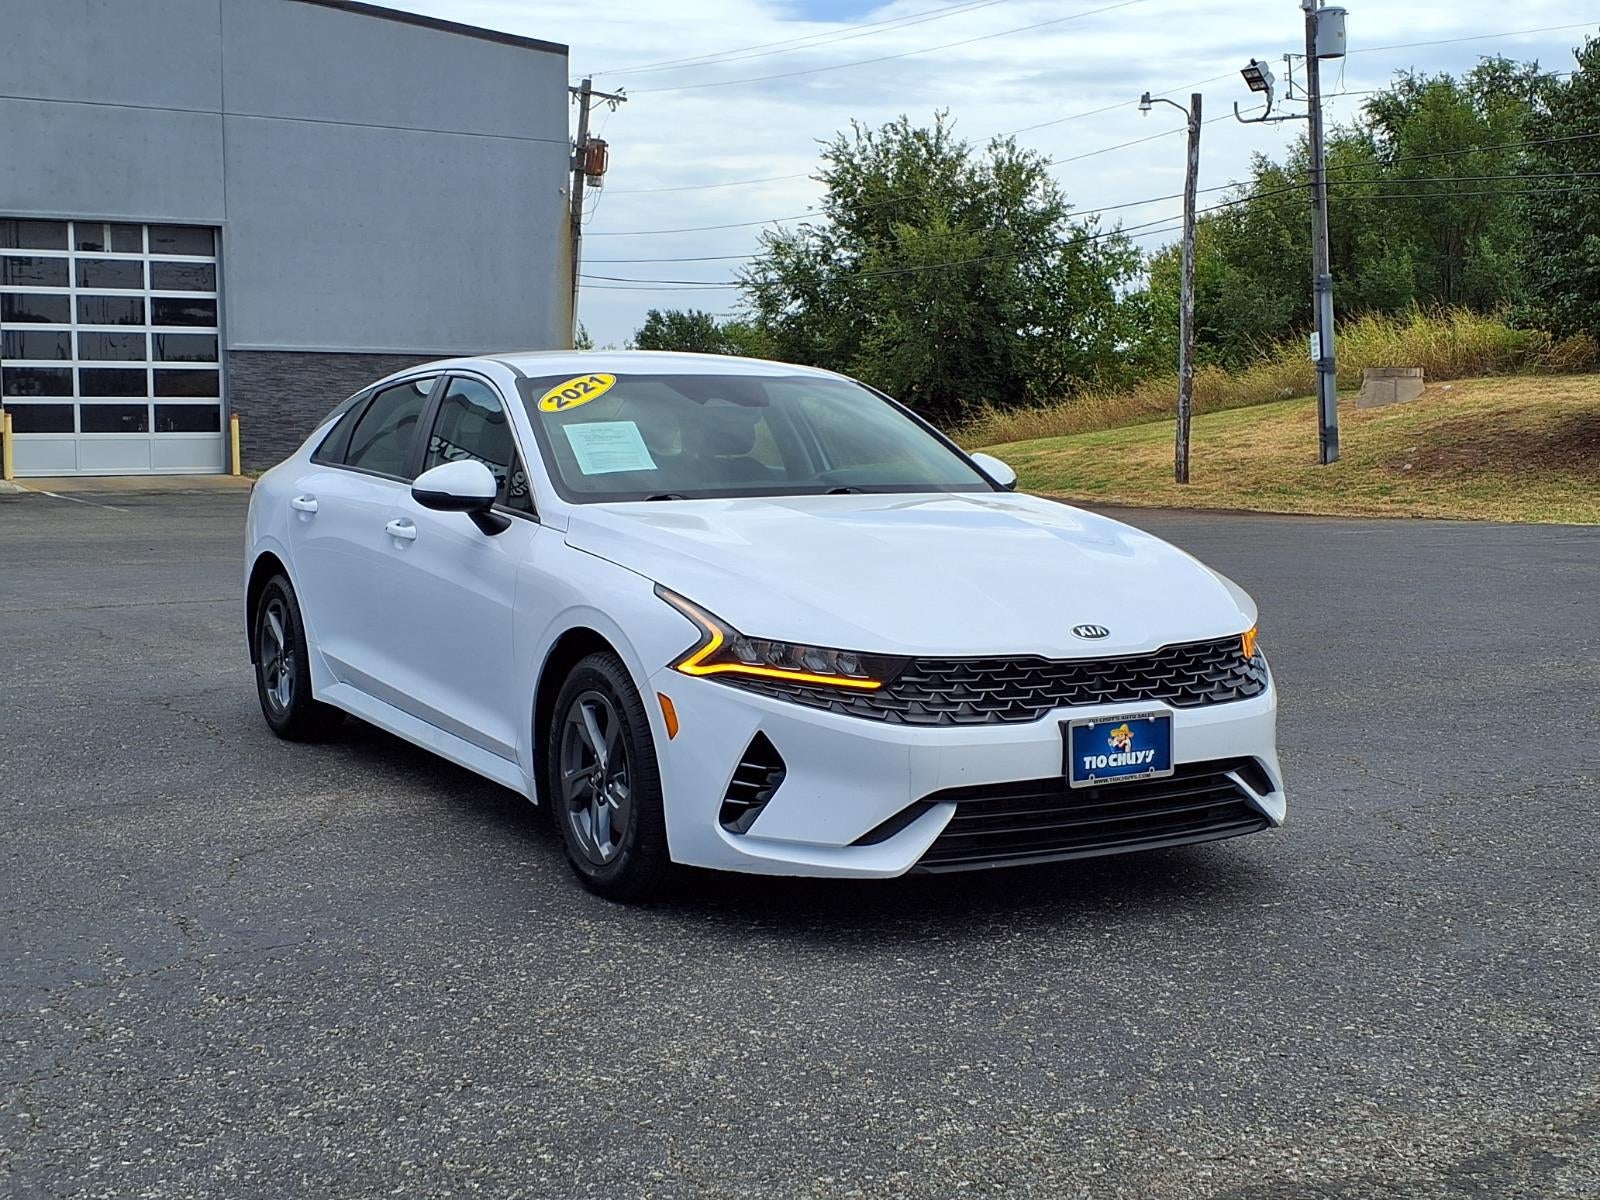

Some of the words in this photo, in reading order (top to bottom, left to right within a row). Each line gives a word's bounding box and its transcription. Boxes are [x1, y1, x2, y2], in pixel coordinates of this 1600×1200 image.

[547, 376, 607, 409] 2021
[1076, 625, 1108, 637] KIA
[1083, 755, 1107, 769] TIO
[1108, 749, 1155, 767] CHUY'S
